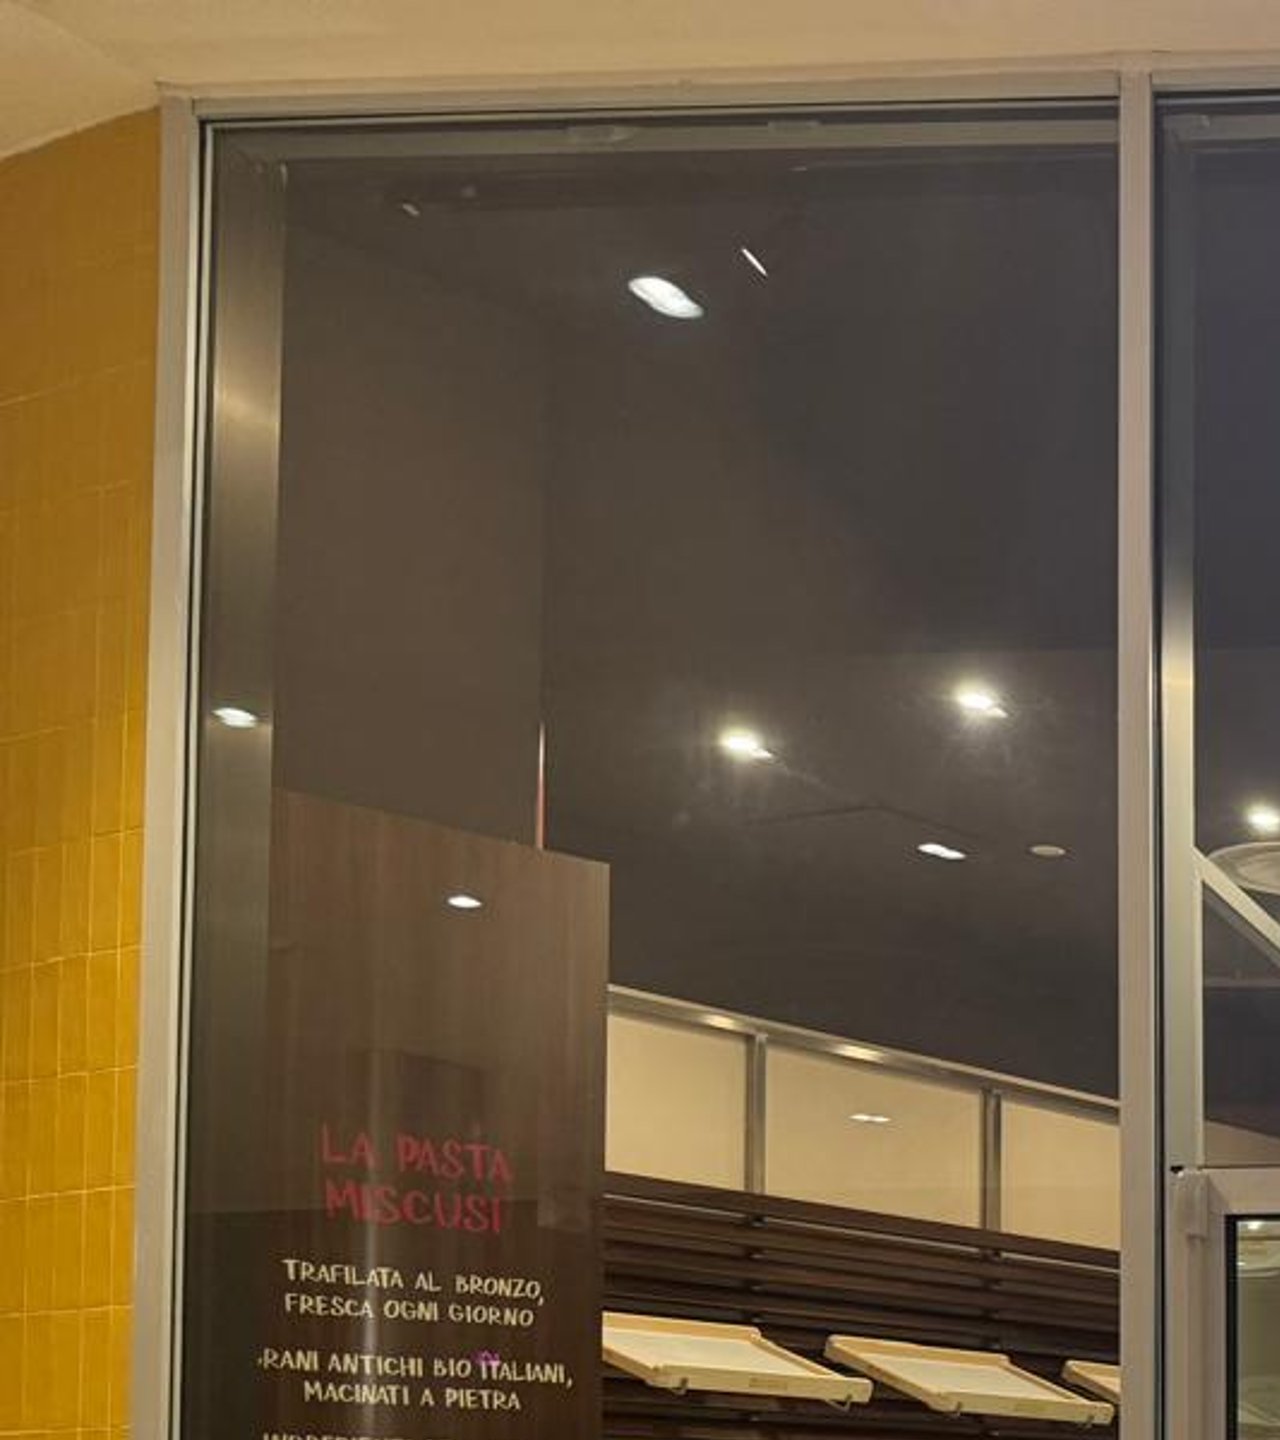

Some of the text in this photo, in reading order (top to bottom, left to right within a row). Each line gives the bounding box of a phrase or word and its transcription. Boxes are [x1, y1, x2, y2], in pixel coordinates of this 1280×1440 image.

[321, 1121, 514, 1184] LA PASTA
[324, 1178, 503, 1233] MISCUSI
[281, 1259, 545, 1306] TRAFILATA AL BRONZO,
[284, 1293, 534, 1327] FRESCA OGNI GIORNO
[258, 1348, 573, 1389] RANI ANTICHI BIO ITALIANI,
[303, 1380, 521, 1411] MACINATI A PIETRA
